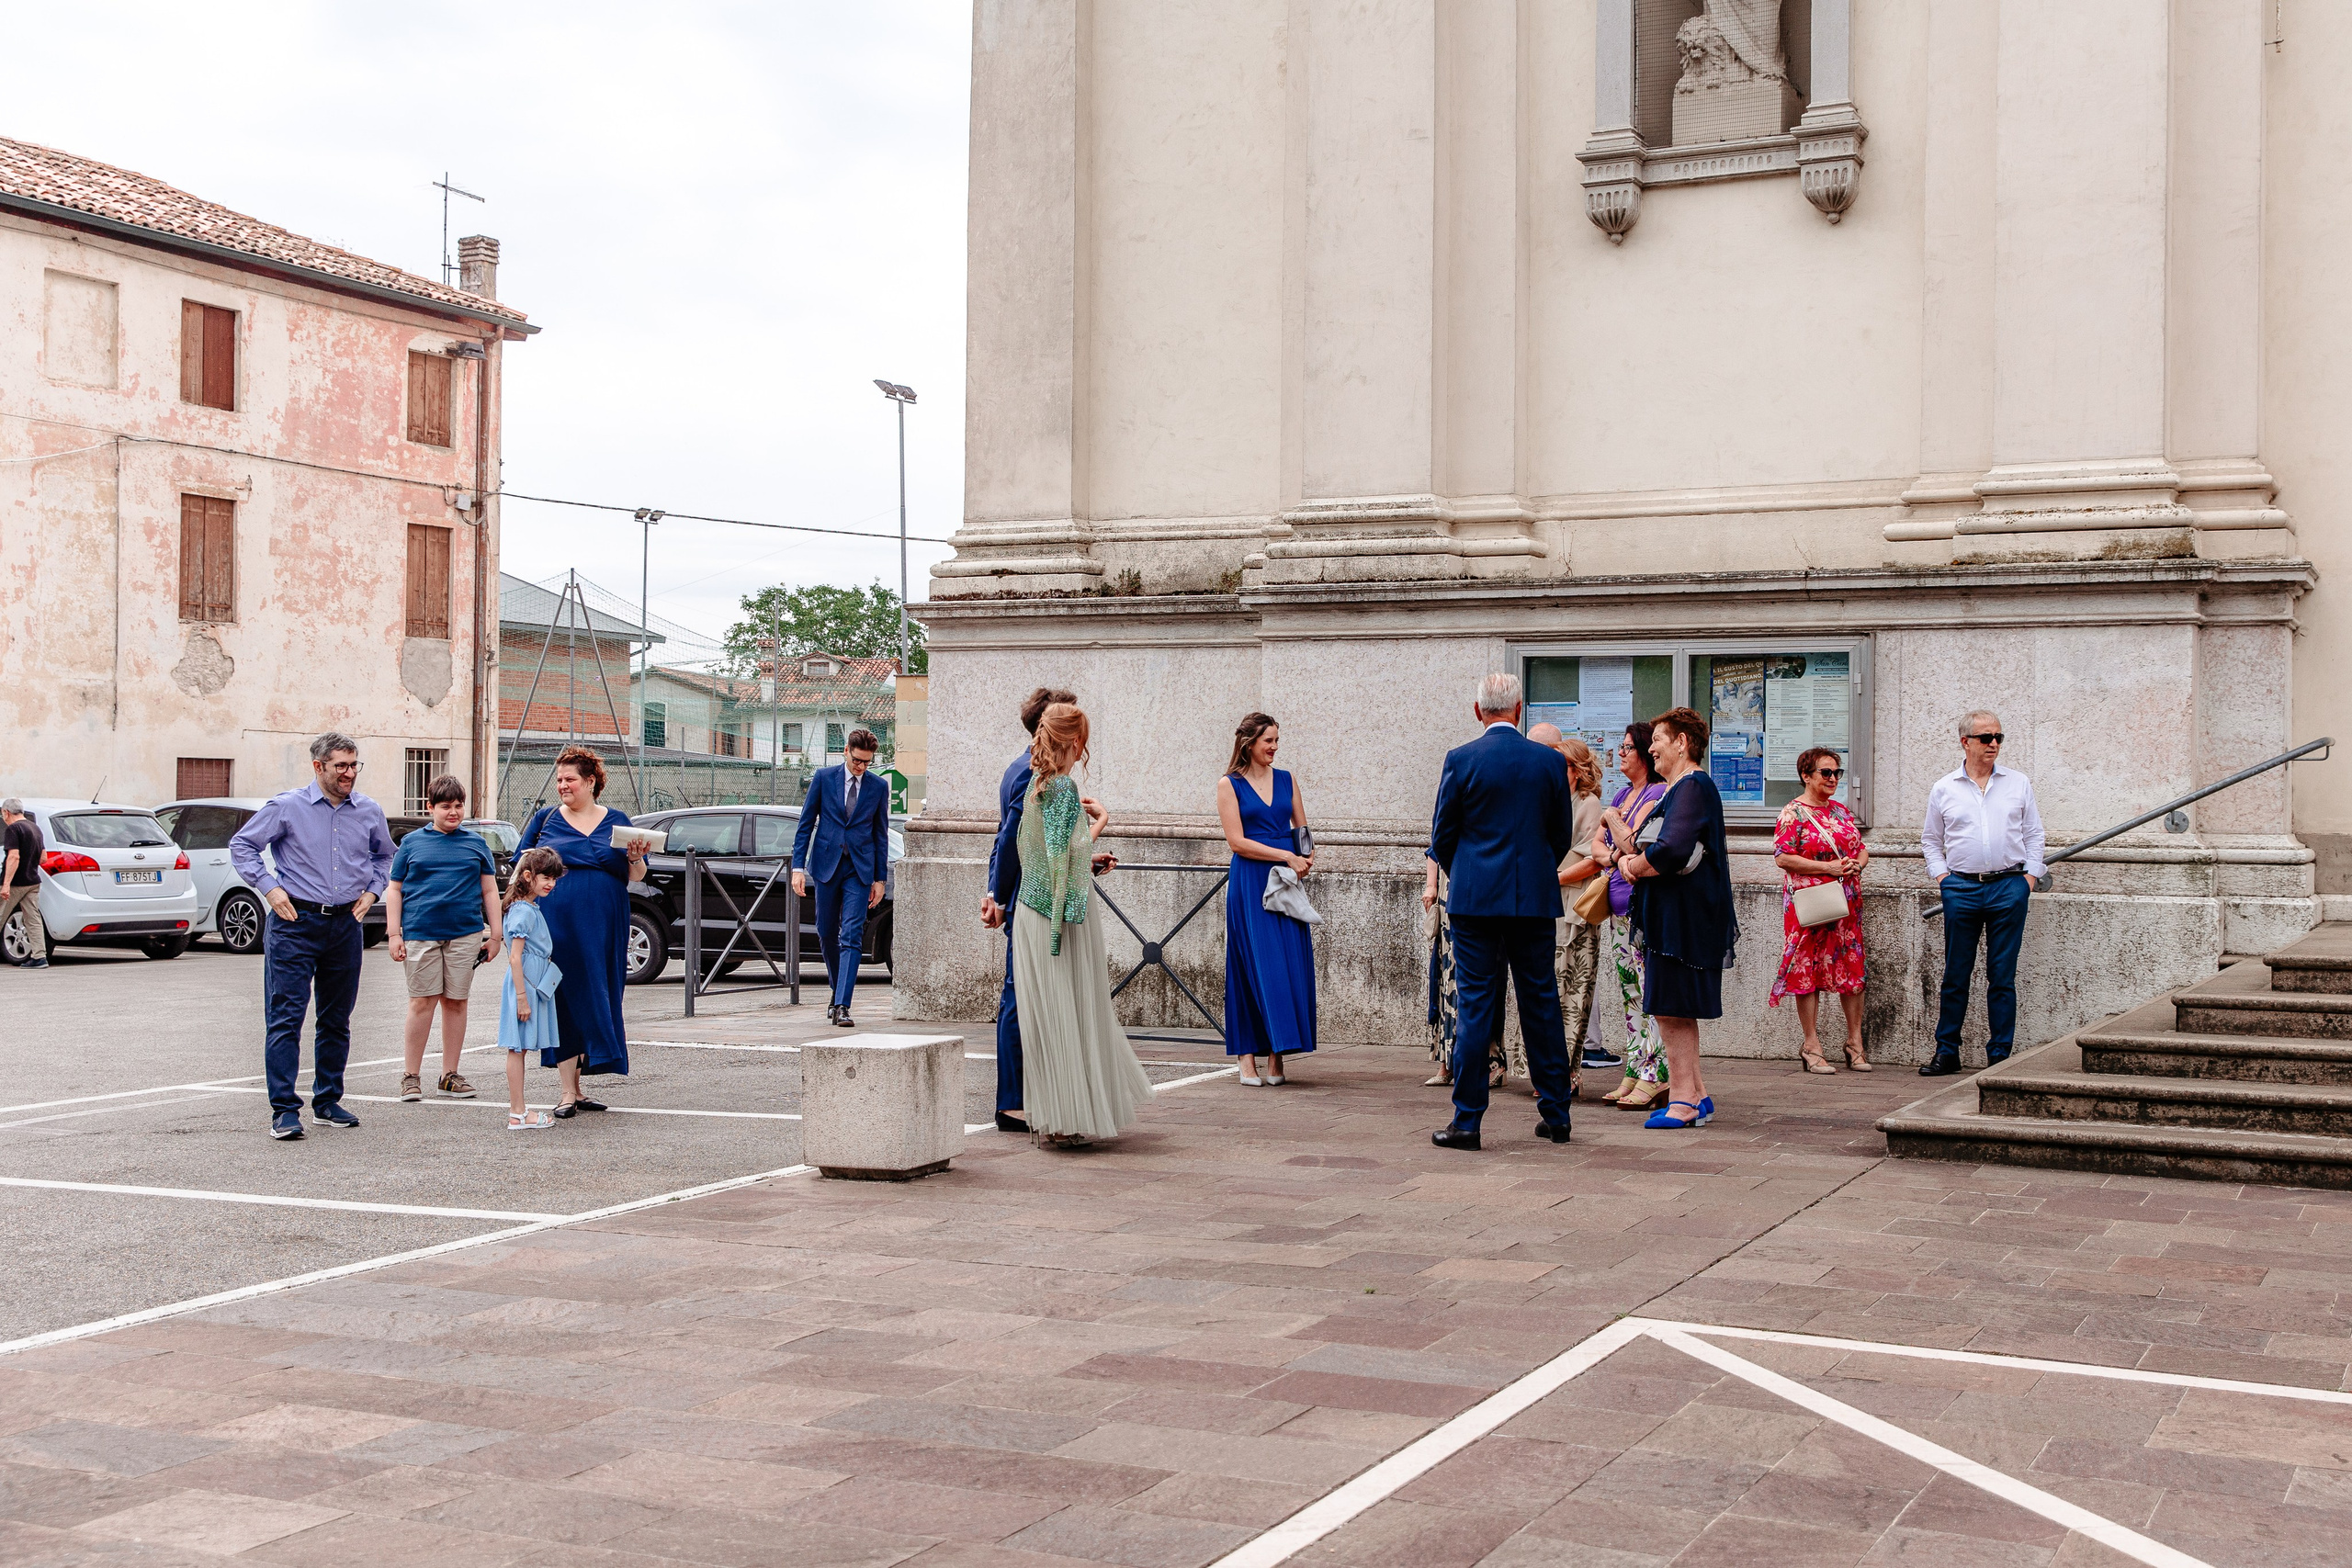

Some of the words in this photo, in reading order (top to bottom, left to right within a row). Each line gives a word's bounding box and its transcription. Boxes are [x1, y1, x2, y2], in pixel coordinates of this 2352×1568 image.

[1815, 658, 1829, 667] San
[1724, 673, 1764, 683] QUOTIDIANO.
[120, 873, 130, 882] FF
[131, 872, 157, 882] 875TJ
